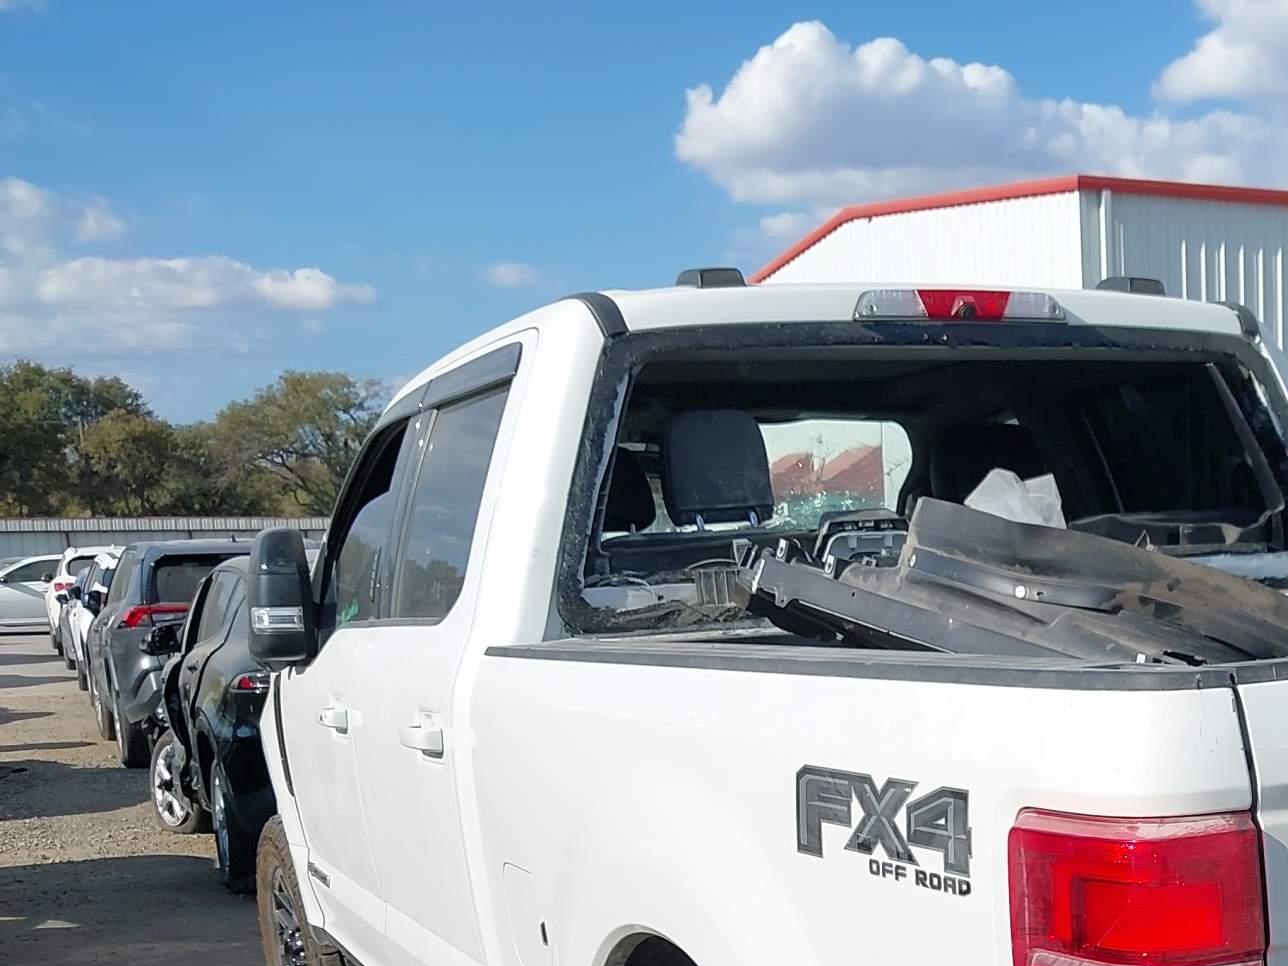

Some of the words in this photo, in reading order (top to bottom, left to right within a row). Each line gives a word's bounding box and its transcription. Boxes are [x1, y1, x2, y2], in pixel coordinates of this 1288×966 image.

[796, 764, 972, 878] FX4
[869, 858, 907, 881] OFF
[915, 868, 972, 897] ROAD
